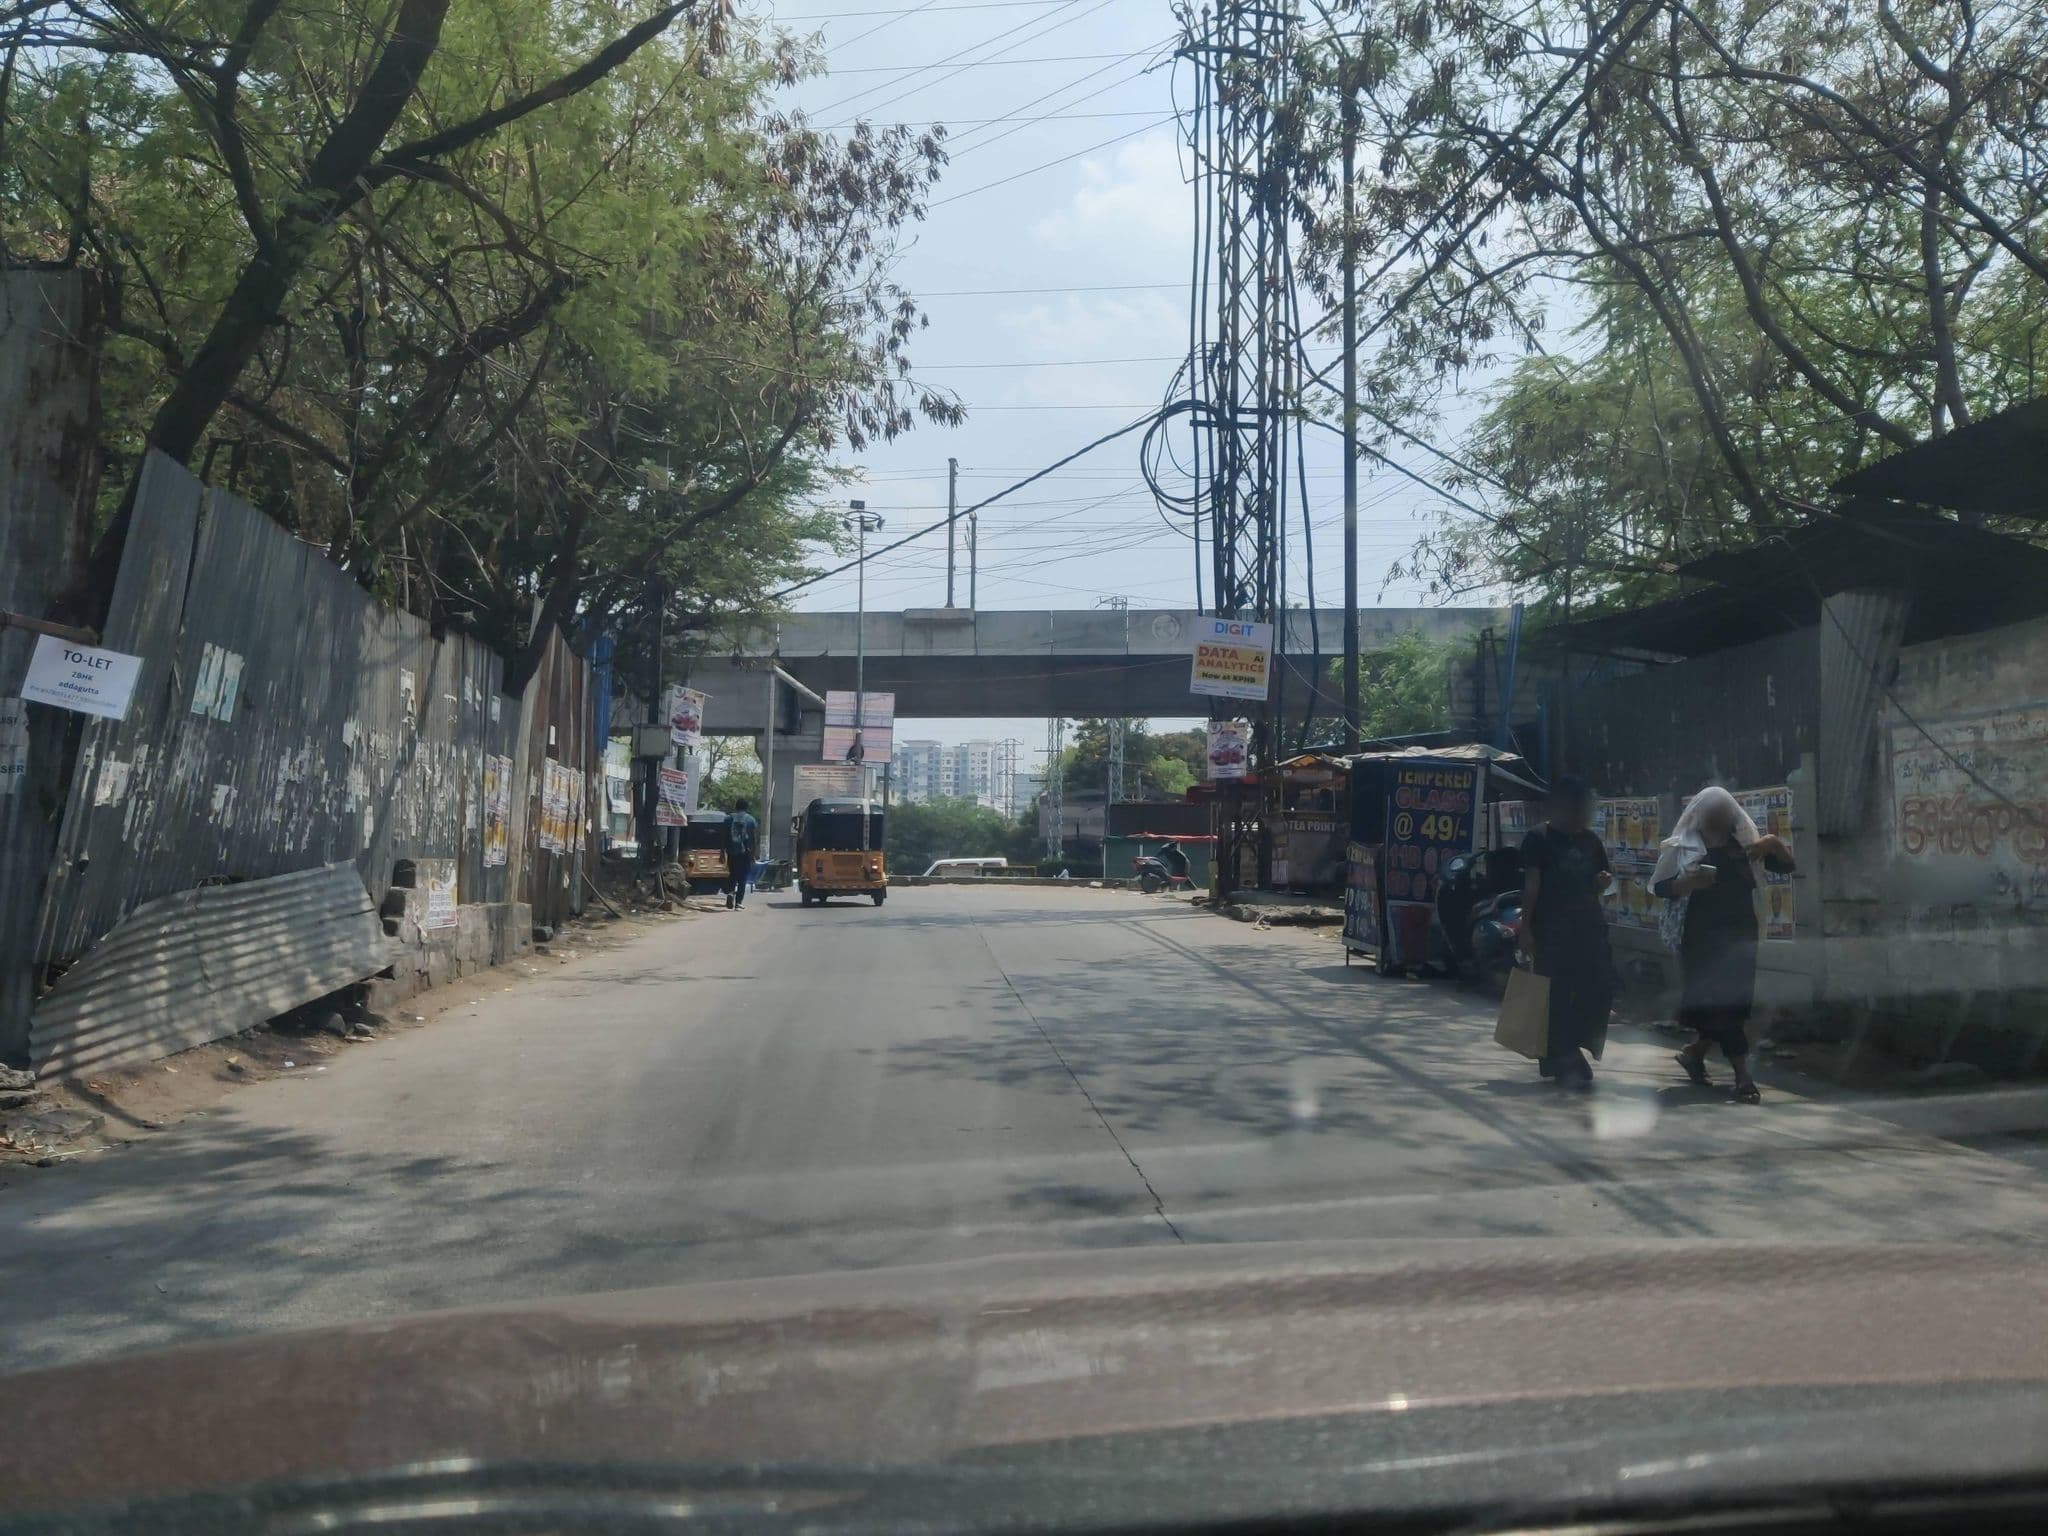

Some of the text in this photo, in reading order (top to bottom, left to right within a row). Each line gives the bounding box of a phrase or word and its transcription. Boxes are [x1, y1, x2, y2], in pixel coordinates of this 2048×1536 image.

[1215, 622, 1253, 636] DIGIT
[64, 650, 113, 670] TO-LET
[1199, 647, 1239, 660] DATA
[1253, 655, 1264, 663] AI
[1198, 659, 1264, 673] ANALYTICS
[71, 671, 94, 681] 2BHK
[1202, 671, 1221, 680] Now
[58, 681, 99, 695] addagutta
[1398, 770, 1472, 788] TEMPERED
[1395, 786, 1471, 814] GLASS
[1288, 820, 1337, 833] TEA POINT
[1420, 814, 1468, 842] 49/-
